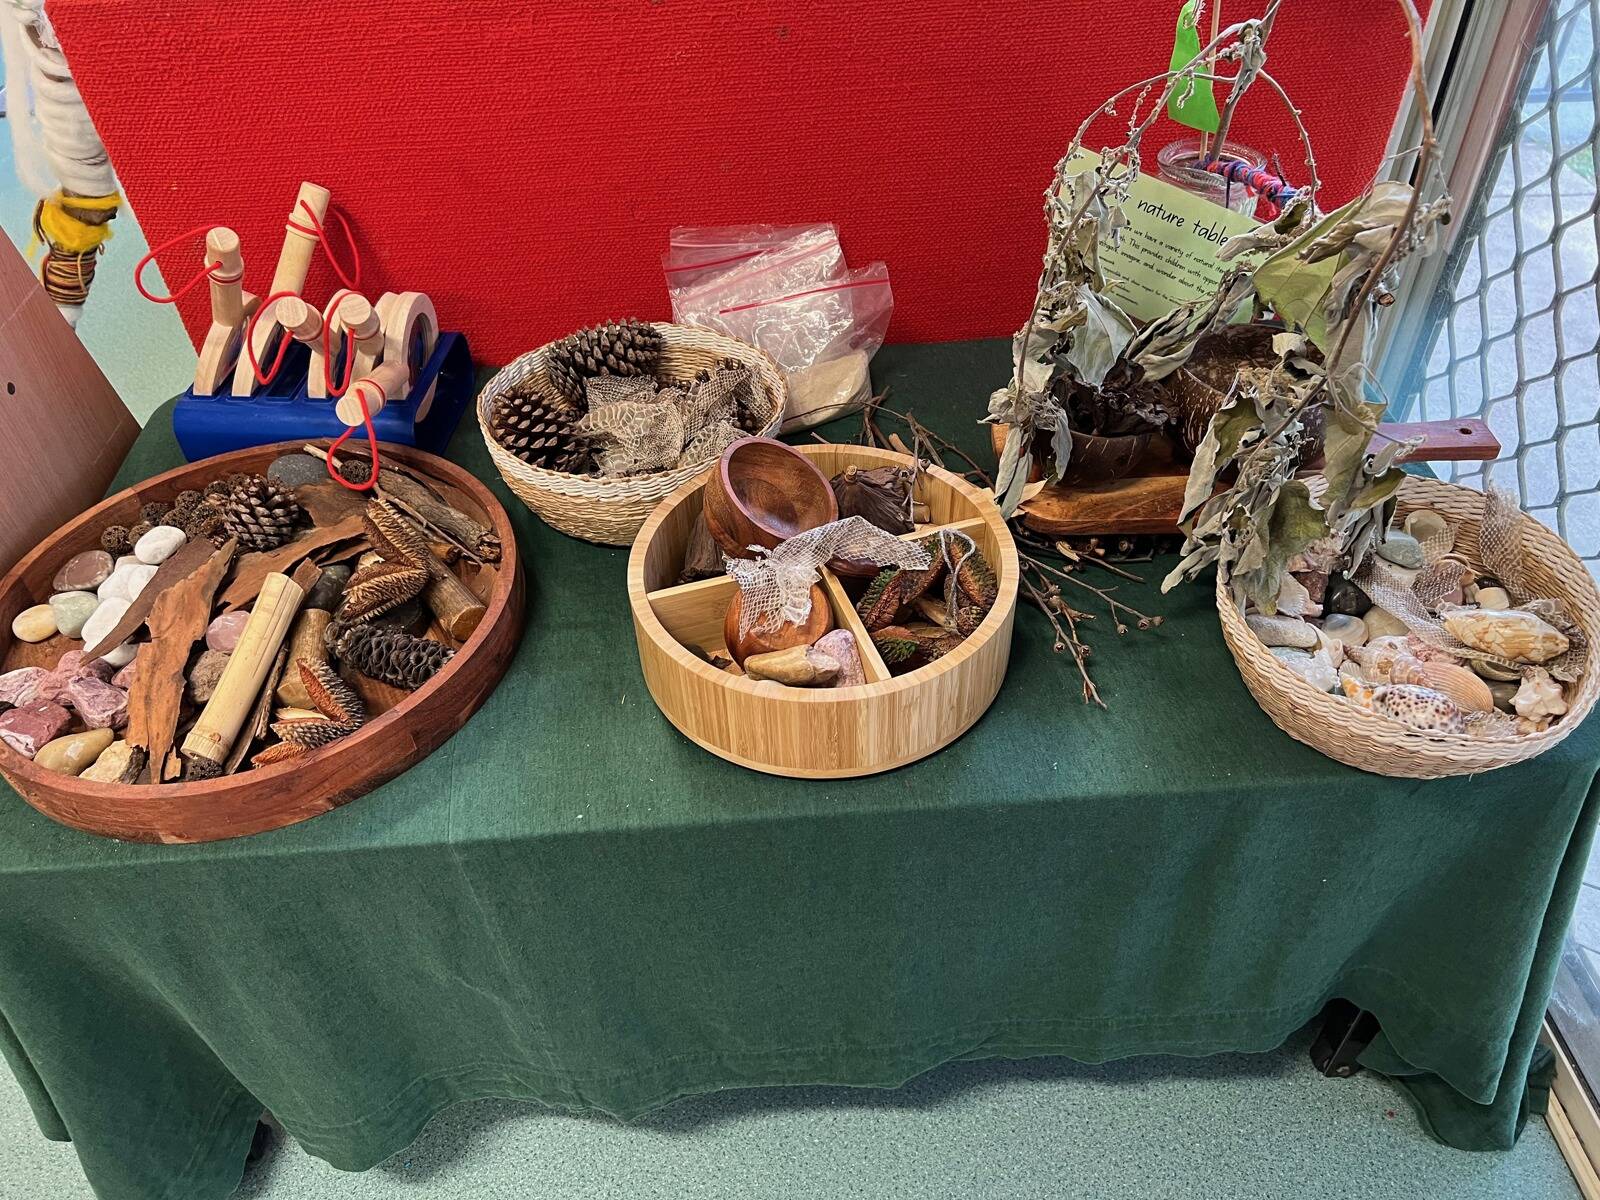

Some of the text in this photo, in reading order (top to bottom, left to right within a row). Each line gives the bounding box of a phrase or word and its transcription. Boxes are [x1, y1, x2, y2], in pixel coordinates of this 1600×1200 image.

[1137, 199, 1185, 227] nature
[1192, 219, 1229, 246] table
[1129, 237, 1141, 250] This
[1140, 247, 1164, 261] provides
[1164, 256, 1186, 270] children
[1187, 268, 1202, 278] with
[1164, 244, 1184, 258] variety
[1185, 251, 1194, 259] of
[1193, 256, 1216, 269] natural
[1143, 261, 1156, 270] and
[1155, 268, 1177, 280] wonder
[1178, 277, 1195, 289] about
